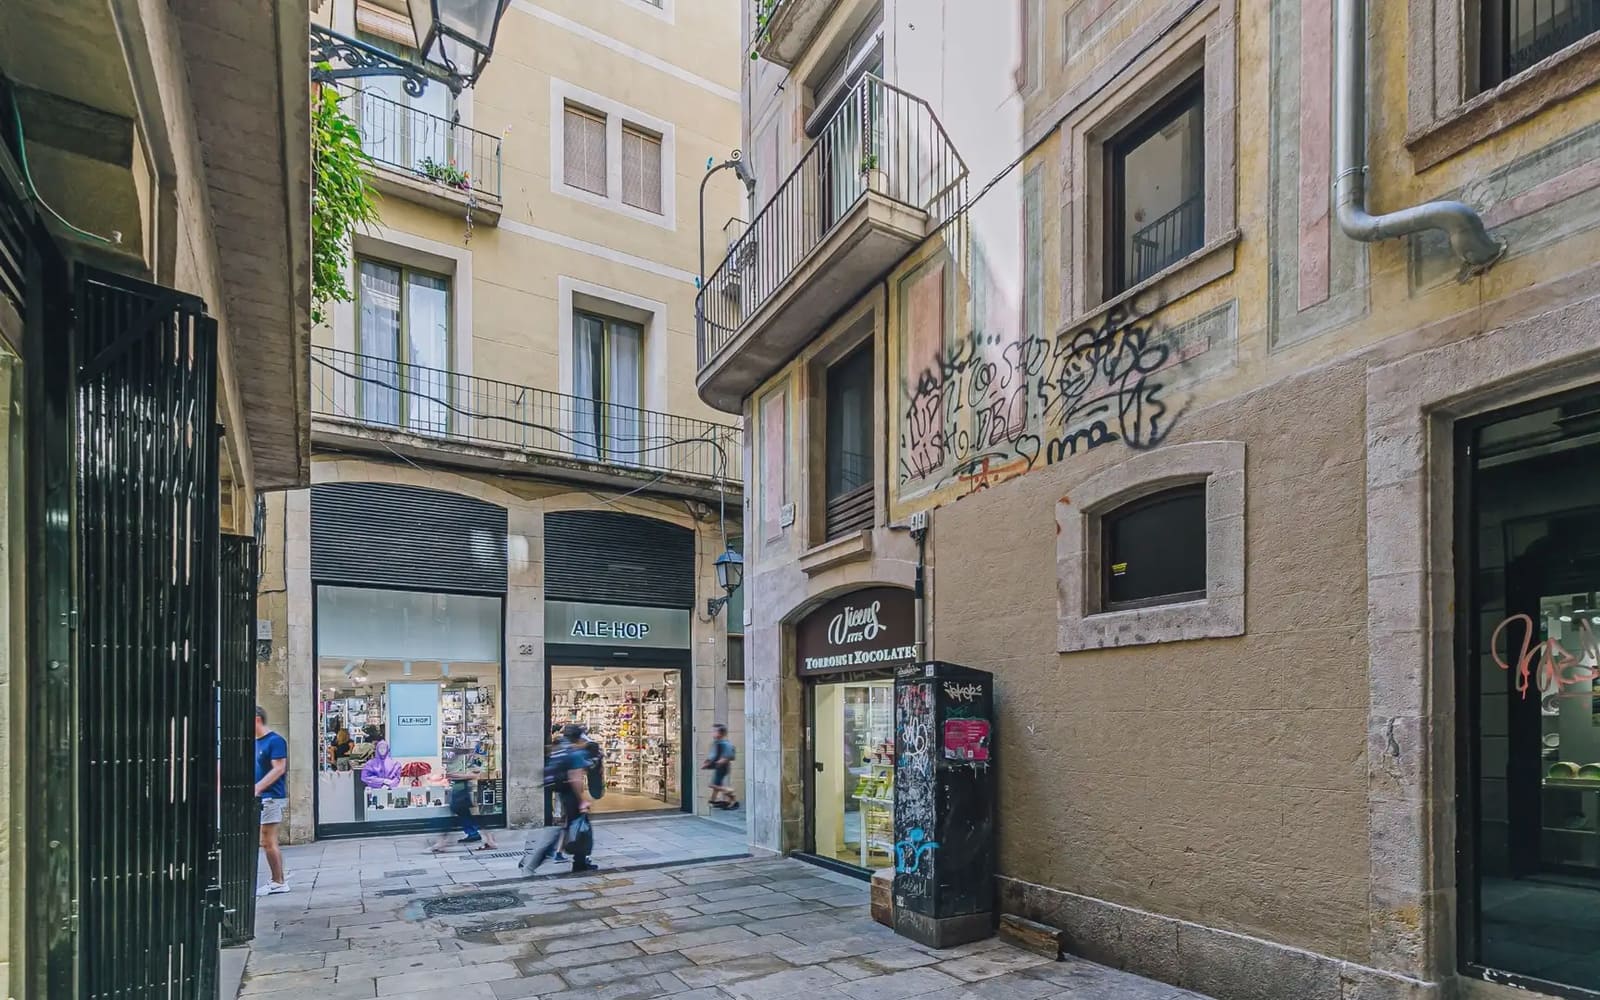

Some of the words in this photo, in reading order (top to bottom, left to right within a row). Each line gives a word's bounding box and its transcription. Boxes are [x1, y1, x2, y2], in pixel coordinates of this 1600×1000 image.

[571, 619, 650, 640] ALE-HOP
[828, 600, 887, 645] Vicens
[846, 632, 864, 644] 1775
[854, 645, 918, 664] XOCOLATES
